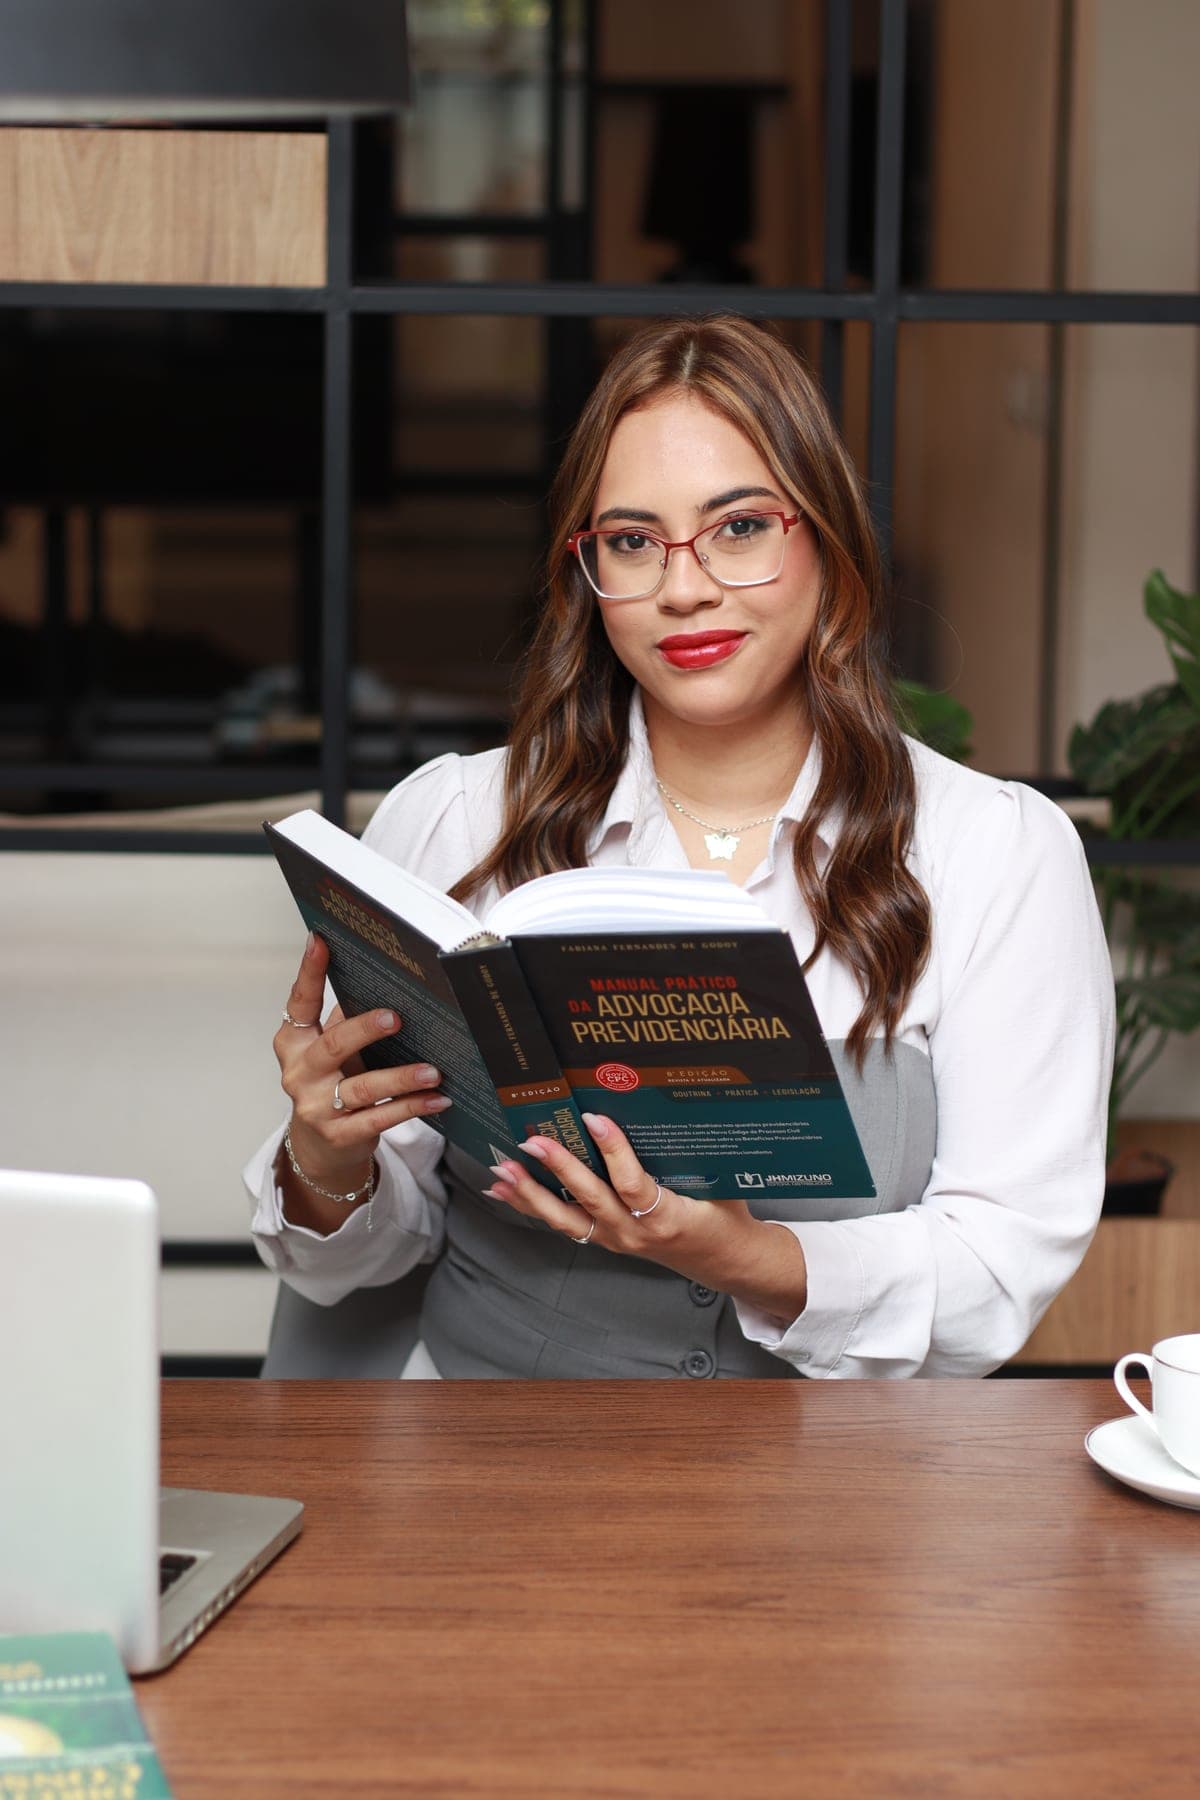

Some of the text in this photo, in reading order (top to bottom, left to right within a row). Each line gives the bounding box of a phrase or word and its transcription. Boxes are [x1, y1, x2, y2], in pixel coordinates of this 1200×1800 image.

[613, 943, 676, 951] FERNANDES
[682, 942, 696, 950] DE
[702, 941, 738, 949] GODOY
[589, 974, 738, 992] MANUAL PRÁTICO
[567, 991, 751, 1017] DA ADVOCACIA
[570, 1014, 792, 1044] PREVIDENCIÁRIA
[607, 1075, 630, 1083] CPC
[679, 1069, 728, 1078] EDIÇÃO
[521, 1086, 560, 1097] EDIÇÃO
[672, 1086, 821, 1098] DOUTRINA PRÁTICA LEGISLAÇÃO
[766, 1173, 833, 1182] JHMIZUNO
